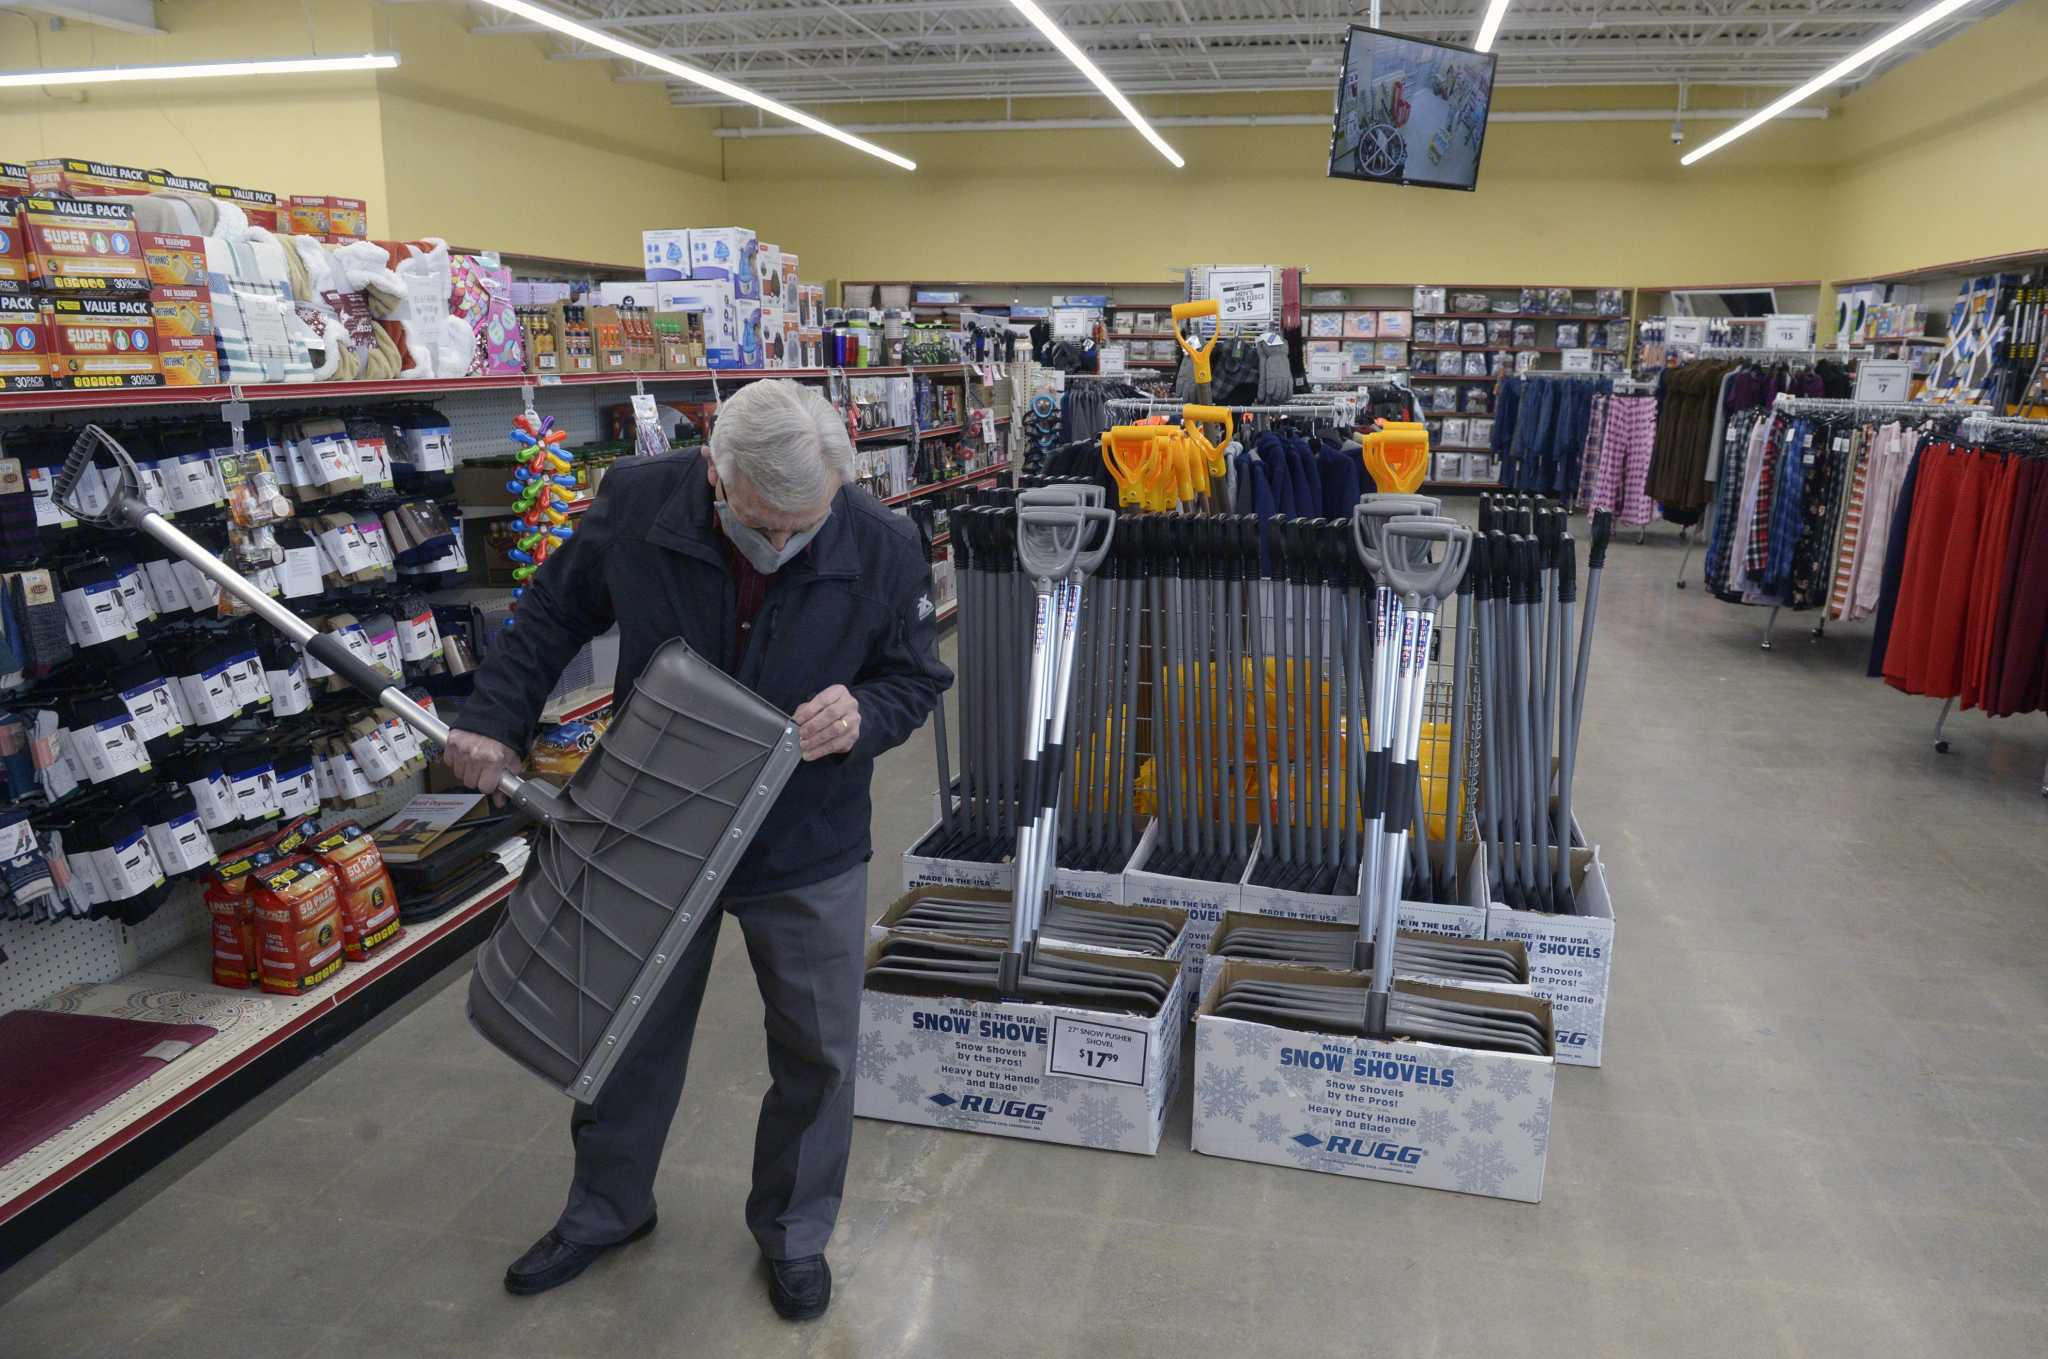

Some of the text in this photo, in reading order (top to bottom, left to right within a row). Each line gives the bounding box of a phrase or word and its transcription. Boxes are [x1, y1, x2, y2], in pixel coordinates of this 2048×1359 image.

[90, 164, 118, 178] VALUE
[119, 167, 144, 181] PACK
[166, 176, 189, 189] VALUE
[189, 179, 208, 192] PACK
[233, 189, 254, 201] VALUE
[255, 192, 274, 203] PACK
[56, 201, 94, 216] VALUE
[96, 204, 128, 218] PACK
[42, 229, 89, 246] SUPER
[1, 297, 34, 310] PACK
[83, 300, 117, 313] VALUE
[119, 302, 148, 314] PACK
[67, 328, 112, 342] SUPER
[918, 873, 943, 884] MADE
[945, 877, 953, 885] IN
[954, 878, 973, 887] THE
[974, 879, 990, 888] USA
[1065, 890, 1083, 898] THE
[1084, 891, 1102, 899] USA
[1142, 896, 1219, 910] MADE IN THE USA
[1189, 910, 1222, 922] OVEL
[1259, 907, 1338, 923] MADE IN THE USA
[1408, 919, 1419, 928] IN
[1421, 921, 1439, 930] THE
[1442, 923, 1461, 932] USA
[1505, 930, 1589, 946] MADE IN THE USA
[1538, 942, 1601, 959] SHOVELS
[1540, 966, 1583, 978] Shovels
[1531, 975, 1578, 988] he Pros!
[1532, 991, 1595, 1005] uty Handle
[949, 1007, 1037, 1025] MADE IN THE USA
[912, 1011, 1048, 1045] SNOW SHOVE
[1080, 1027, 1104, 1039] SNOW
[1104, 1031, 1132, 1043] PUSHER
[1086, 1037, 1114, 1049] SHOVEL
[1555, 1030, 1589, 1046] GG
[955, 1041, 1028, 1059] Snow Shovels
[1322, 1043, 1417, 1064] MADE IN THE USA
[957, 1051, 1023, 1068] by the Pros!
[941, 1064, 1041, 1085] Heavy Duty Handle
[1280, 1047, 1455, 1089] SNOW SHOVELS
[966, 1078, 1018, 1093] and Blade
[1325, 1079, 1404, 1098] Snow Shovels
[1327, 1090, 1399, 1108] by the Pros!
[959, 1094, 1048, 1121] RUGG
[1308, 1103, 1417, 1127] Heavy Duty Handle
[1334, 1119, 1392, 1134] and Blade
[1326, 1135, 1423, 1165] RUGG
